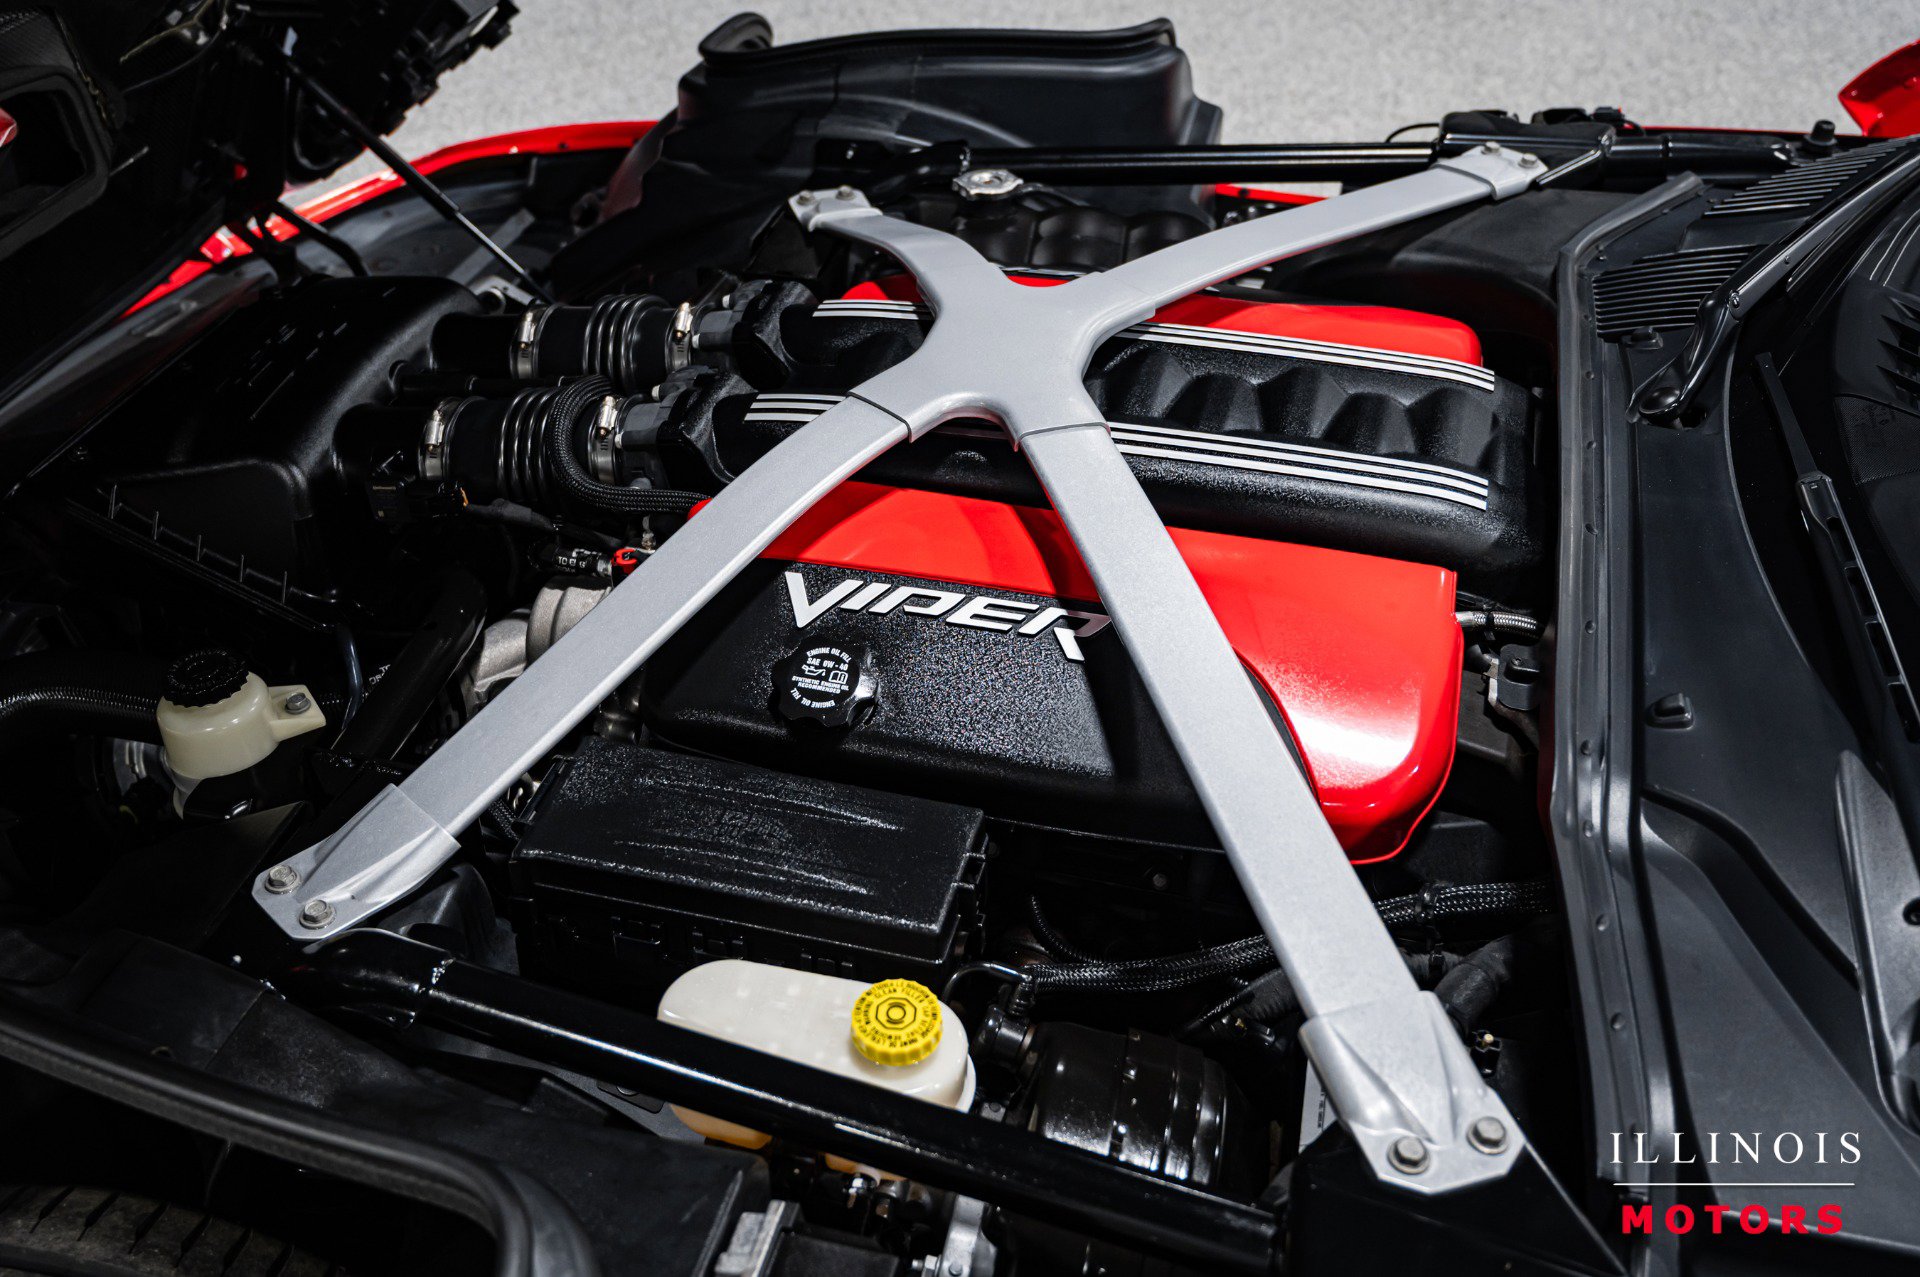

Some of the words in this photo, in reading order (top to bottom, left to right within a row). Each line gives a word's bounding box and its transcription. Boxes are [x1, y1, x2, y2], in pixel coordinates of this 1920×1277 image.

[785, 571, 1112, 662] VIPER
[806, 647, 830, 657] ENGINE
[831, 647, 841, 656] OIL
[840, 651, 852, 663] FILL
[806, 657, 821, 666] SAE
[791, 675, 820, 685] SYNTHETIC
[820, 681, 841, 689] ENGINE
[797, 681, 841, 694] RECOMMENDED
[790, 687, 802, 700] FILL
[801, 697, 812, 706] OIL
[811, 700, 836, 709] ENGINE
